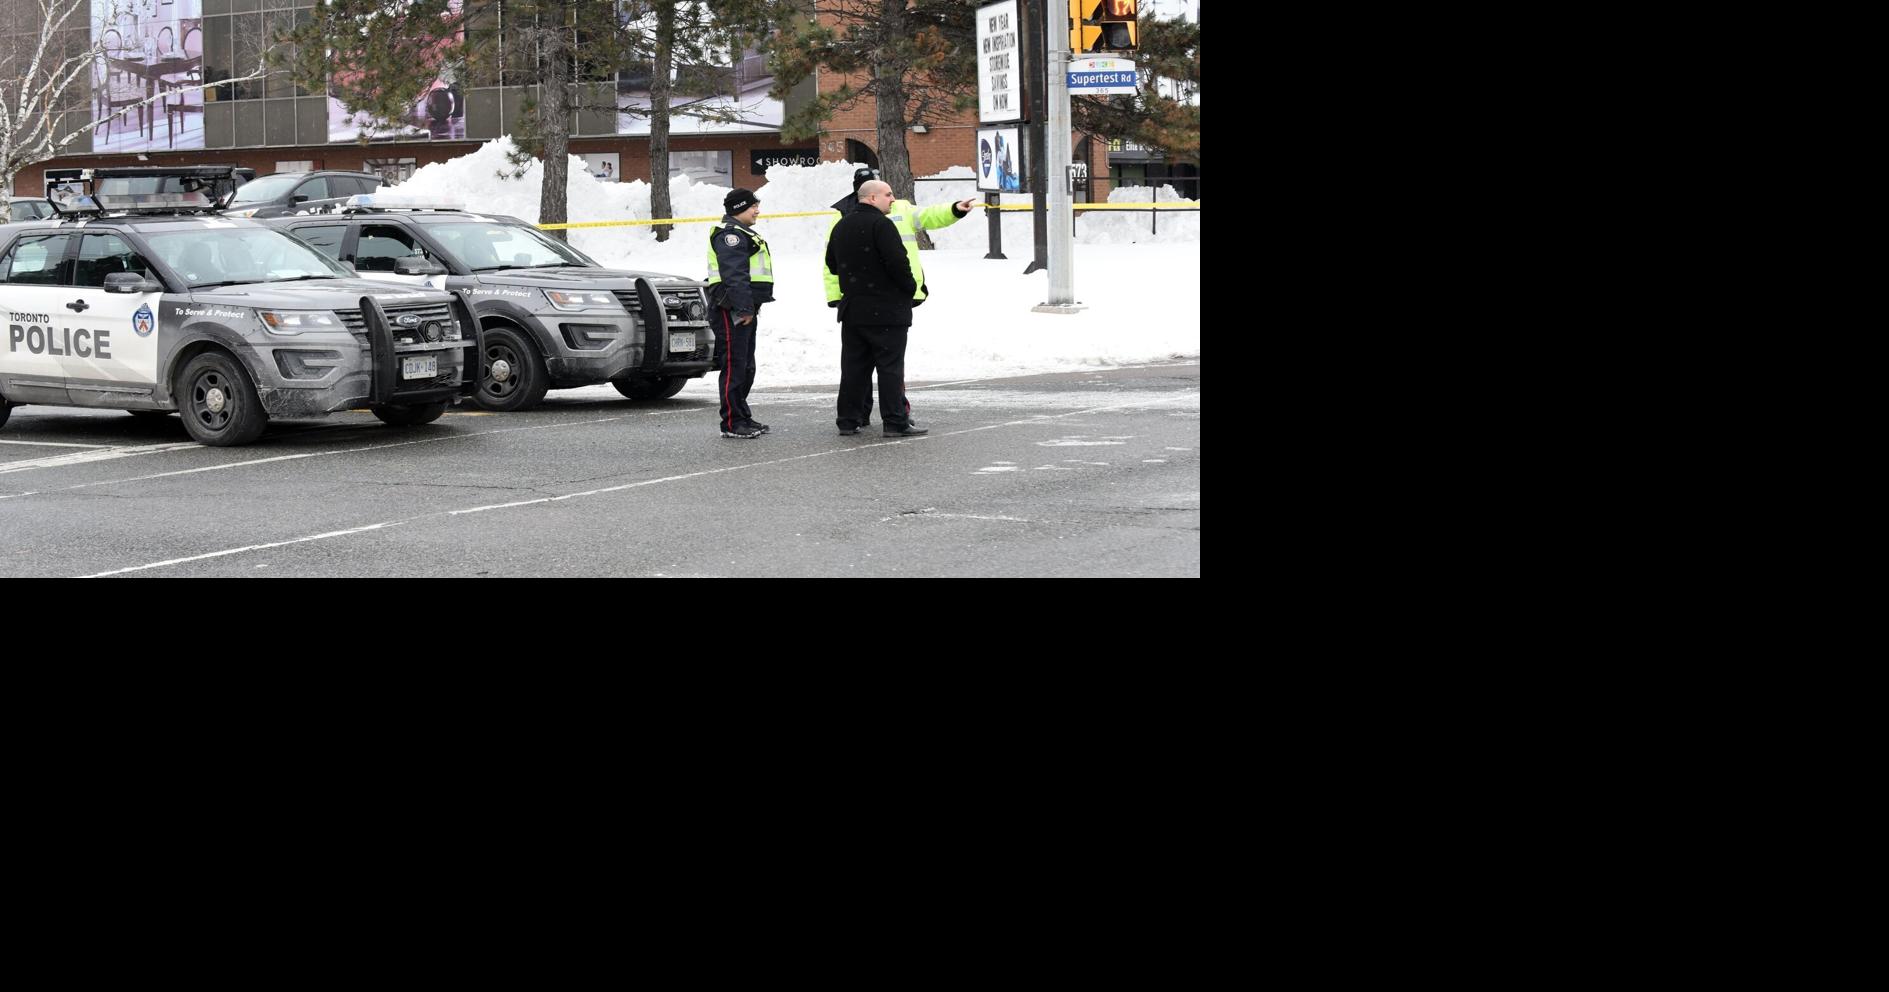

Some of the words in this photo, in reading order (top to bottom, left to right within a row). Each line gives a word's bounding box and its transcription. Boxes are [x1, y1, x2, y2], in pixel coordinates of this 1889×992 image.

[988, 15, 997, 33] NEW
[998, 12, 1009, 31] YEAR
[983, 36, 991, 54] NEW
[989, 52, 1010, 72] STOREWIDE
[991, 73, 1008, 91] SAVINGS
[1071, 72, 1119, 87] Supertest
[1121, 73, 1132, 83] Rd
[993, 94, 998, 111] ON
[999, 92, 1008, 110] NOW
[733, 201, 747, 209] POLICE
[502, 289, 531, 298] Protect
[9, 312, 50, 324] TORONTO
[185, 308, 206, 316] Serve
[214, 309, 245, 319] Protect
[9, 324, 112, 360] POLICE
